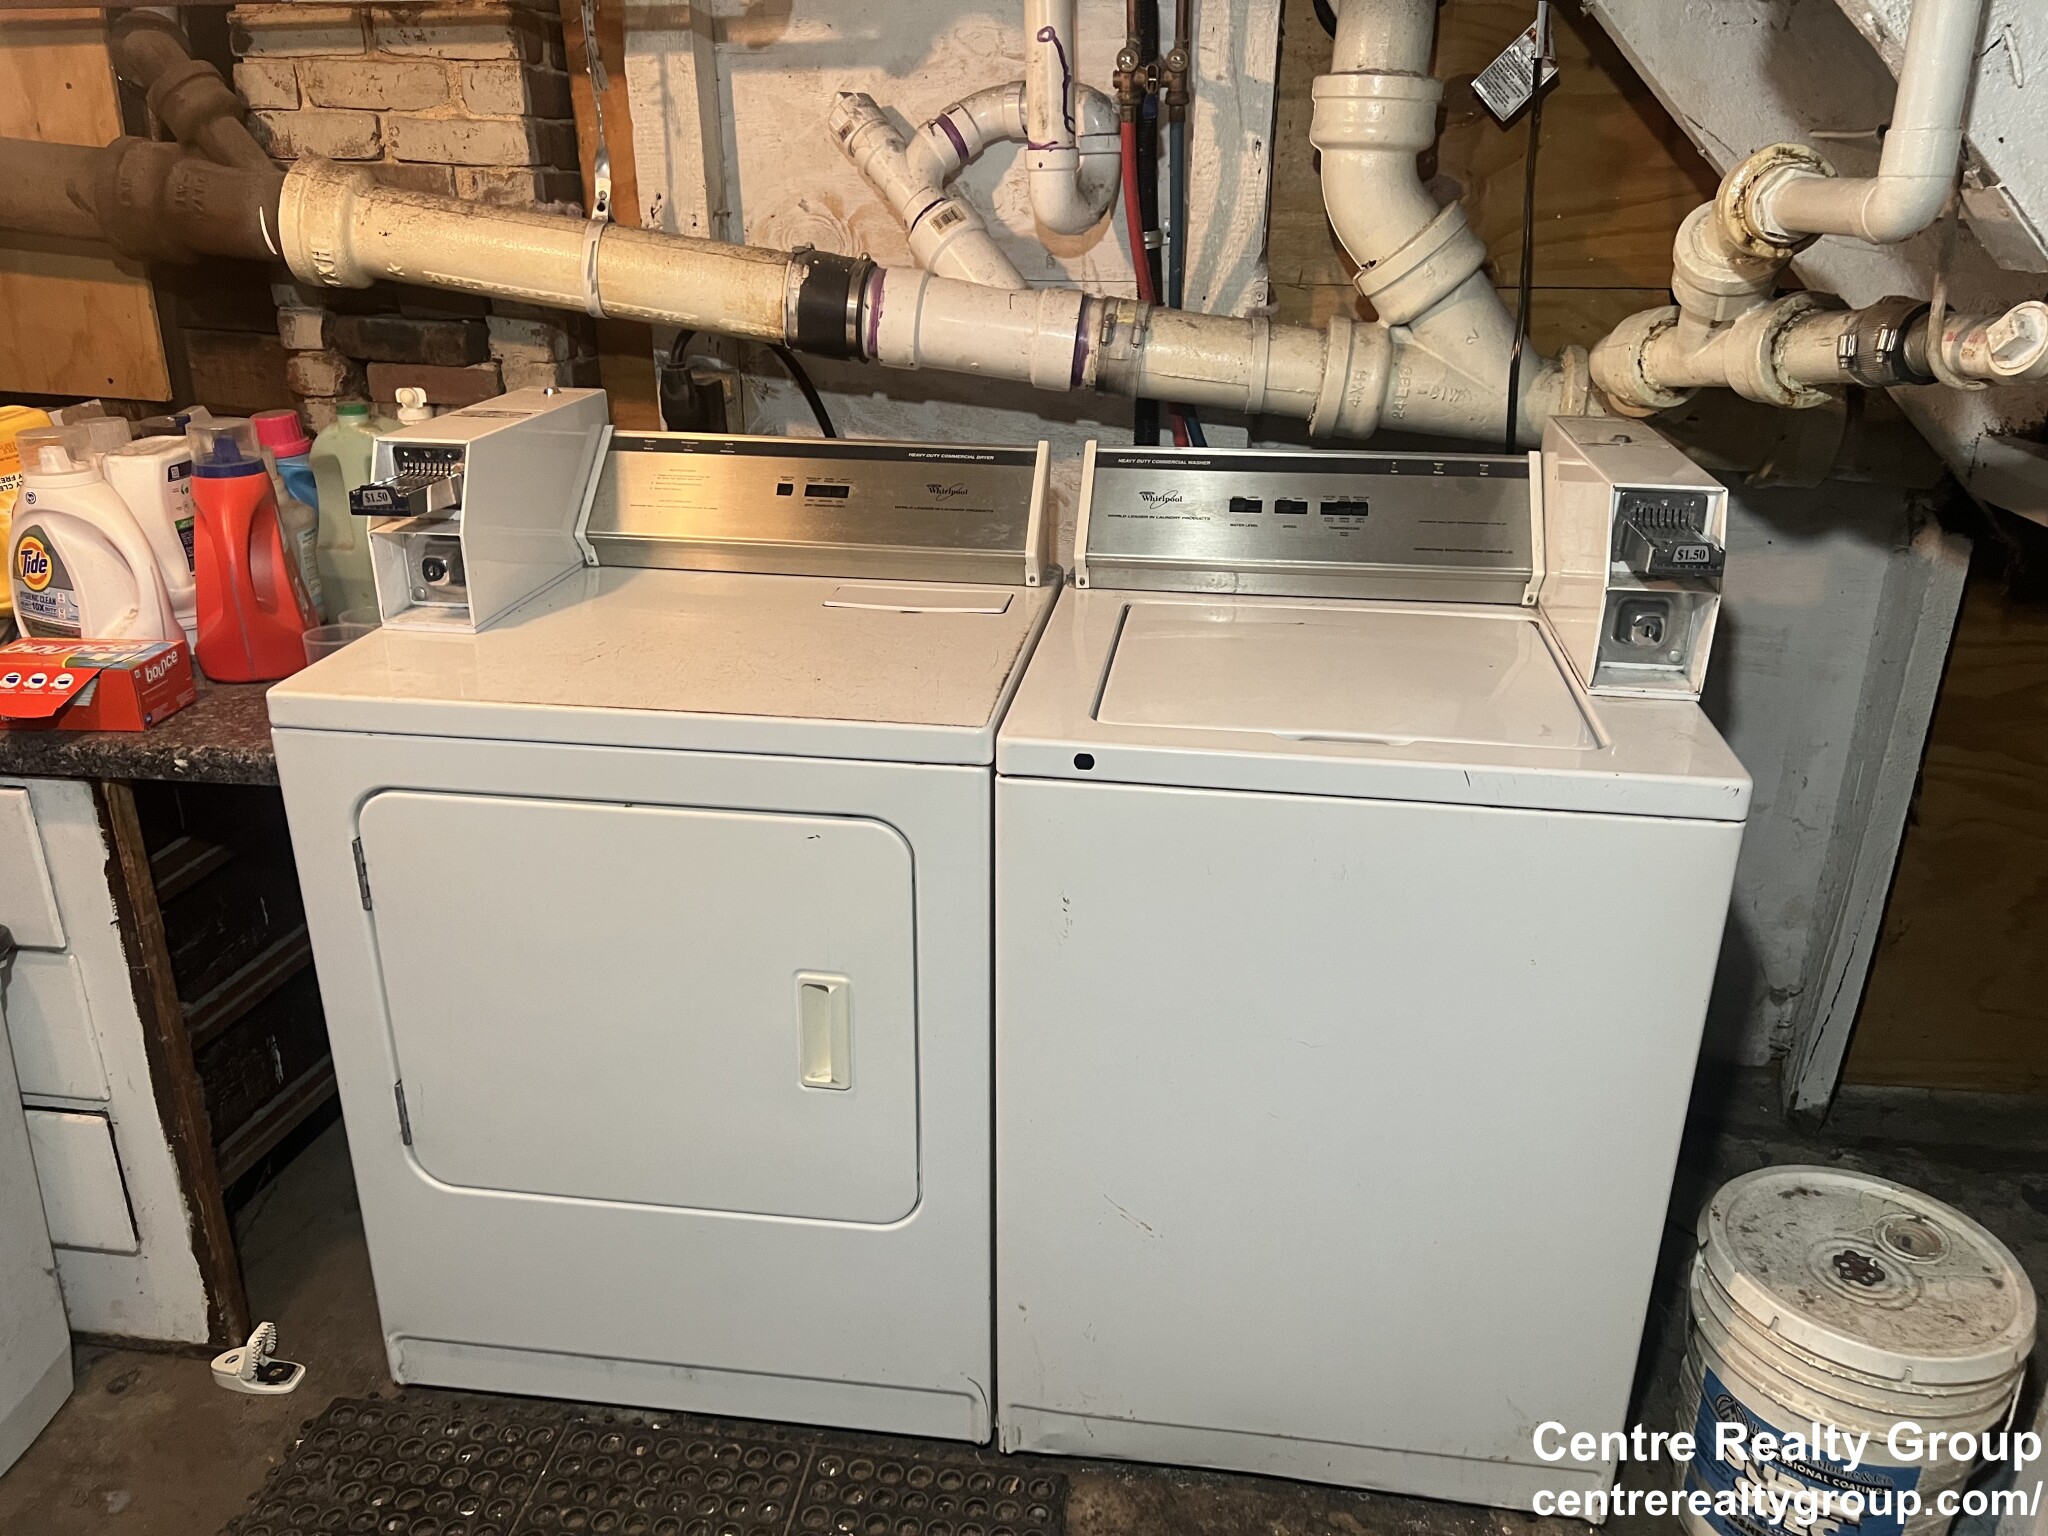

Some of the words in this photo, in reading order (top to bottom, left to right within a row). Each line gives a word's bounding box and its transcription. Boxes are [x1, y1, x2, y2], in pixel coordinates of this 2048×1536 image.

[364, 491, 389, 504] $1.50
[926, 483, 968, 499] Whirlpool
[1139, 491, 1183, 507] Whirlpool
[1676, 547, 1706, 561] $1.50
[20, 549, 48, 578] Tide
[32, 602, 45, 612] 10X
[39, 594, 57, 606] CLEAN
[1, 641, 143, 656] bounce
[145, 650, 178, 684] bounce
[1815, 1456, 1861, 1482] Mooe
